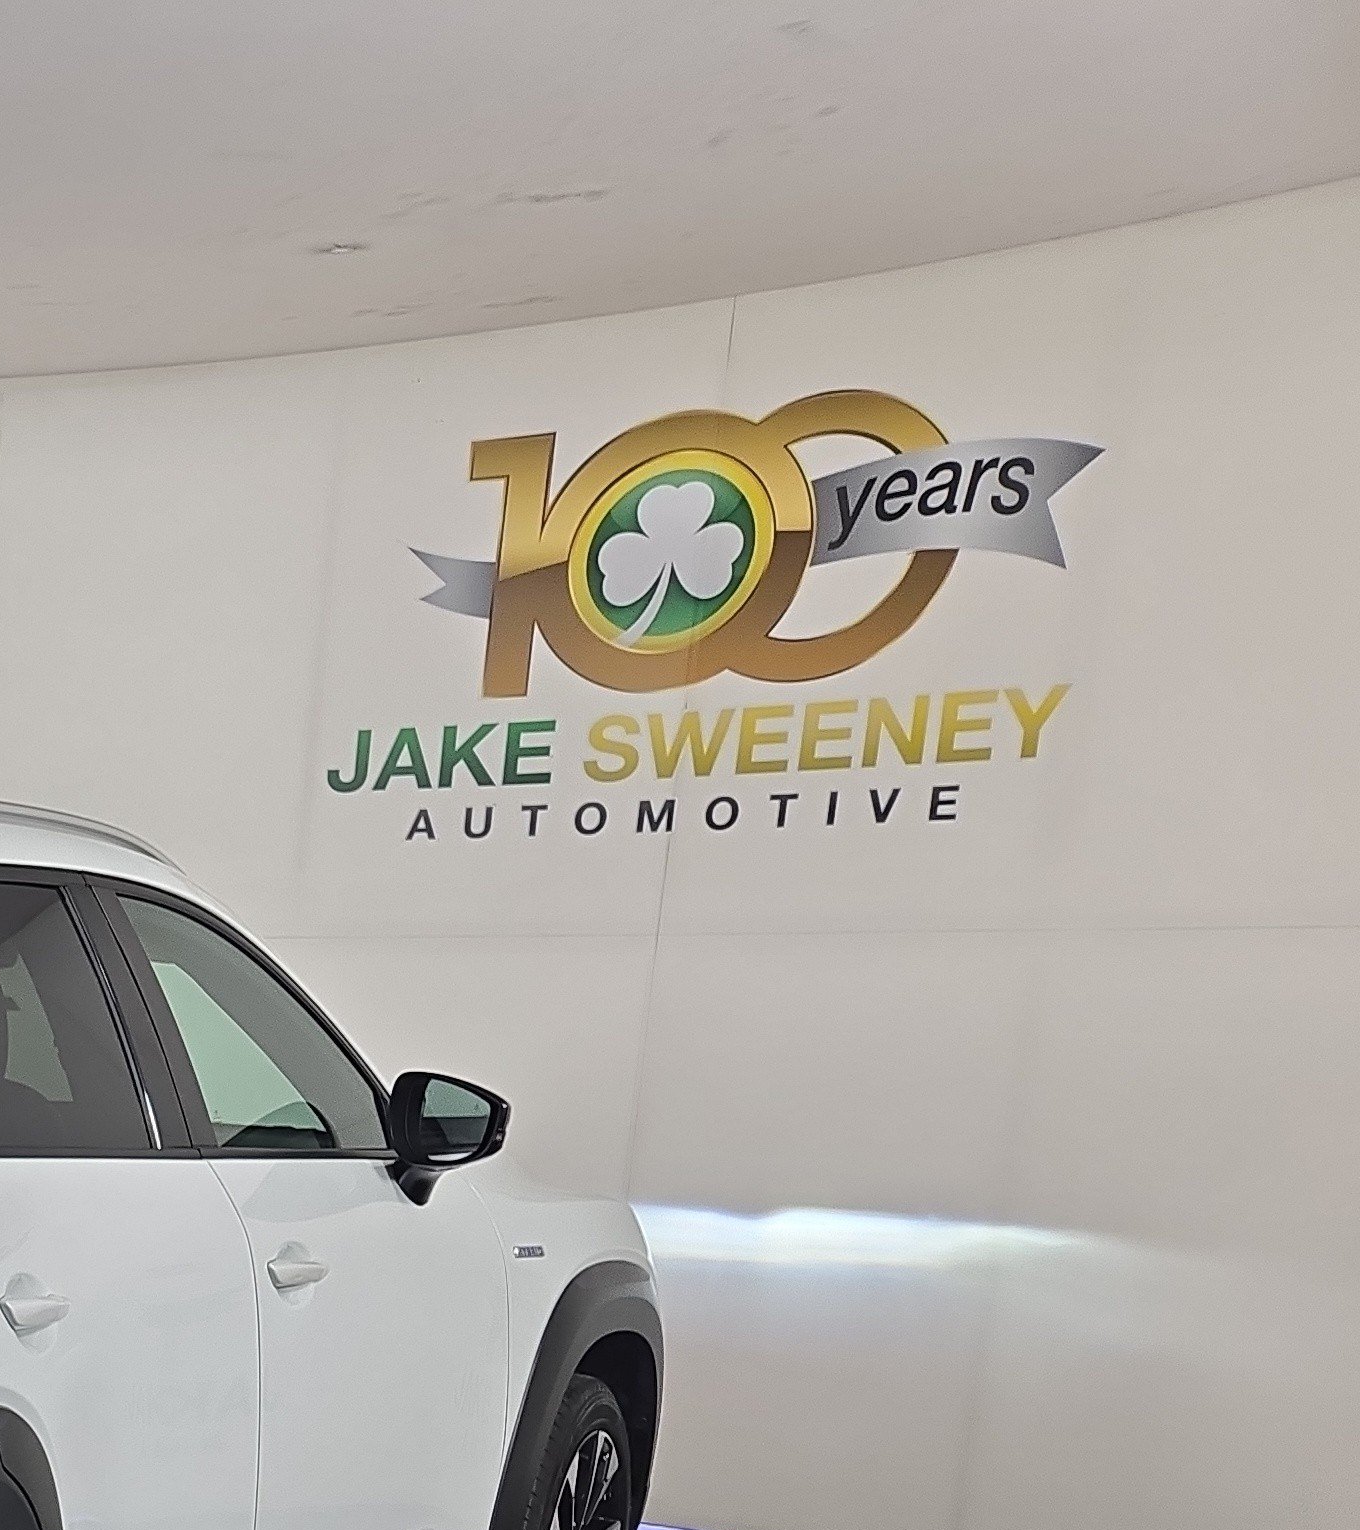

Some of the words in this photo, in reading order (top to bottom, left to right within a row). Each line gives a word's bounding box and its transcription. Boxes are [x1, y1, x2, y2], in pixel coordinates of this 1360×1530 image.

[469, 388, 959, 699] 100
[827, 455, 1037, 551] years
[326, 719, 557, 794] JAKE
[582, 683, 1073, 784] SWEENEY
[406, 784, 962, 843] AUTOMOTIVE
